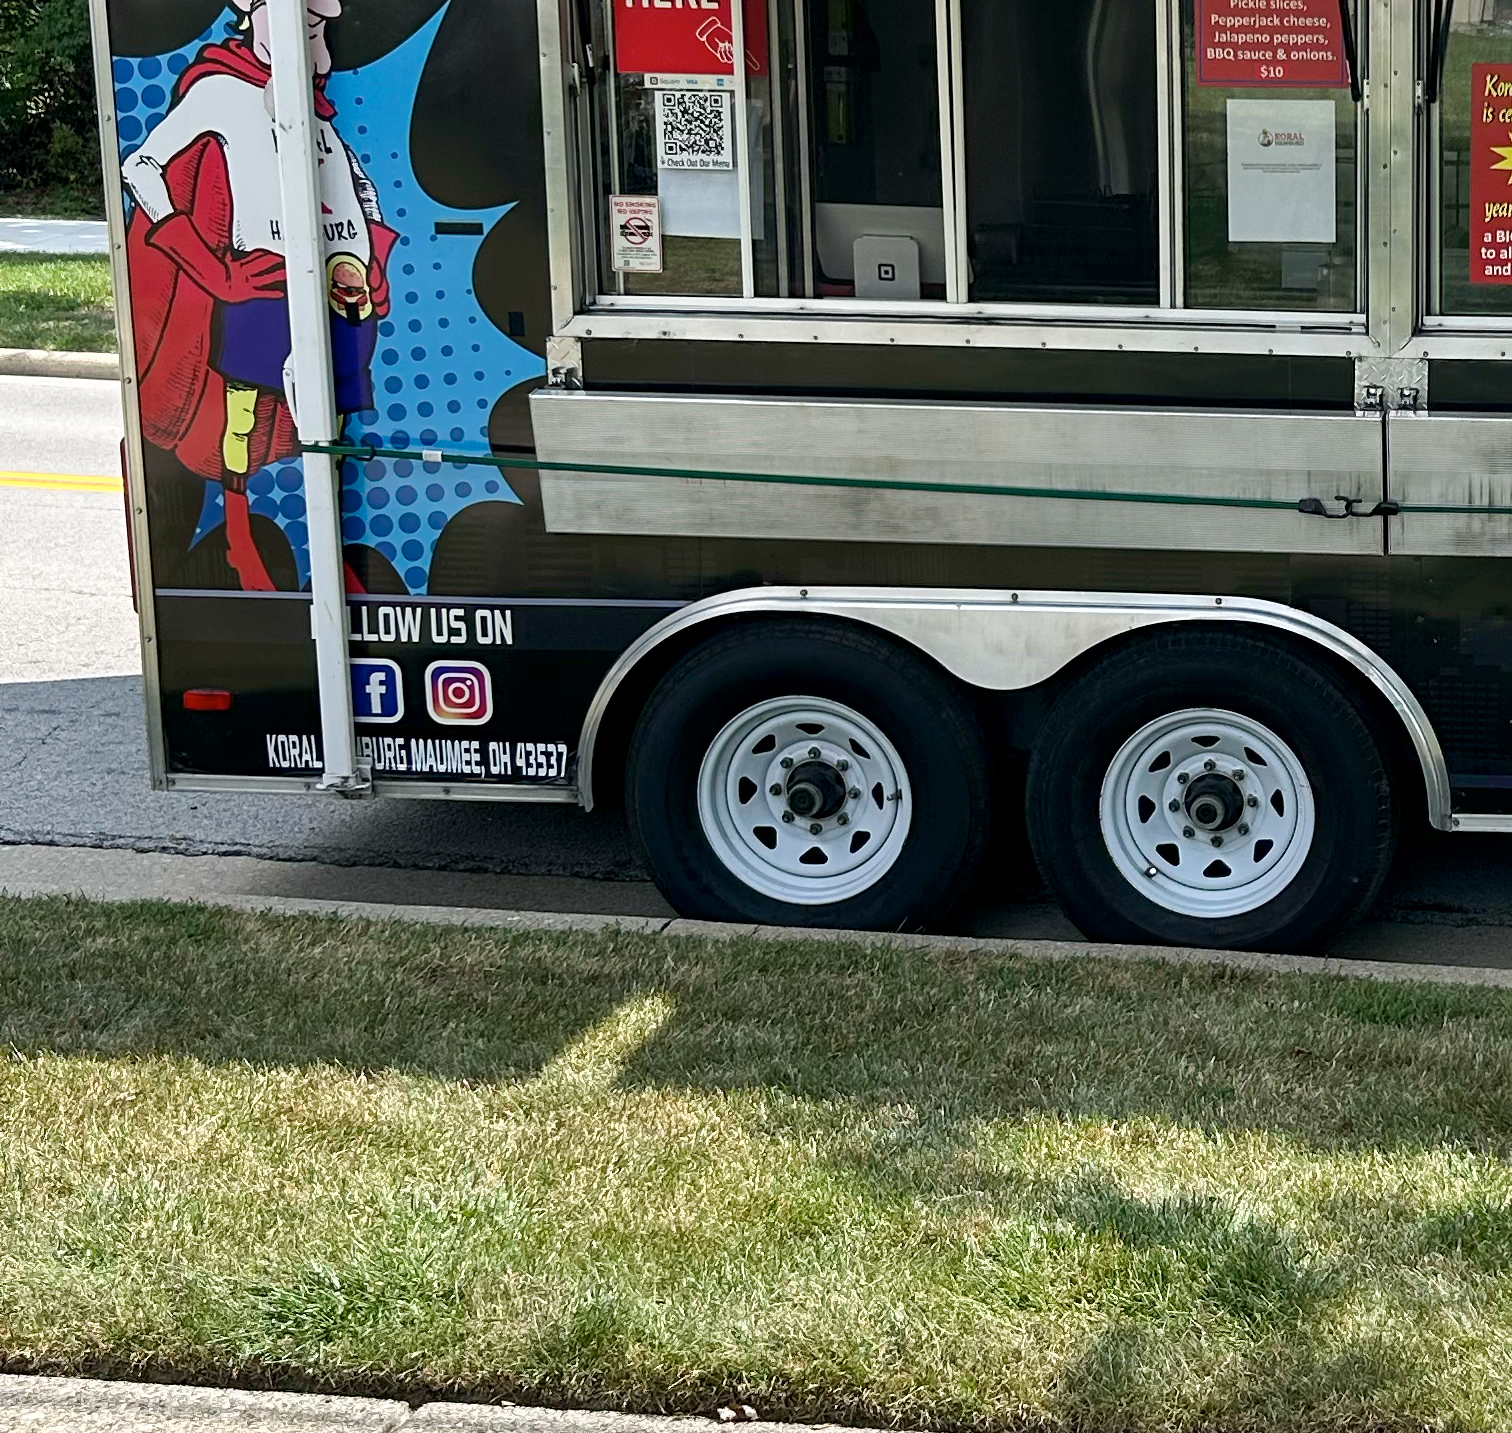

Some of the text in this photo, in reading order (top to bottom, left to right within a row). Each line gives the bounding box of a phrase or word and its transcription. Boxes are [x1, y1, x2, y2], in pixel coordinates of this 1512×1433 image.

[1210, 13, 1331, 29] Pepperjack cheese,
[1213, 30, 1329, 46] Jalapeno peppers,
[1206, 47, 1337, 62] BBQ sauce & onions.
[1260, 64, 1284, 79] $10
[1482, 101, 1494, 123] is
[1483, 232, 1492, 243] a
[1480, 246, 1496, 260] to
[1484, 262, 1512, 276] and
[310, 604, 513, 645] LLOW US ON
[266, 733, 323, 768] KORAL
[411, 738, 485, 779] MAUMEE,
[488, 741, 512, 775] OH
[516, 742, 567, 778] 43537
